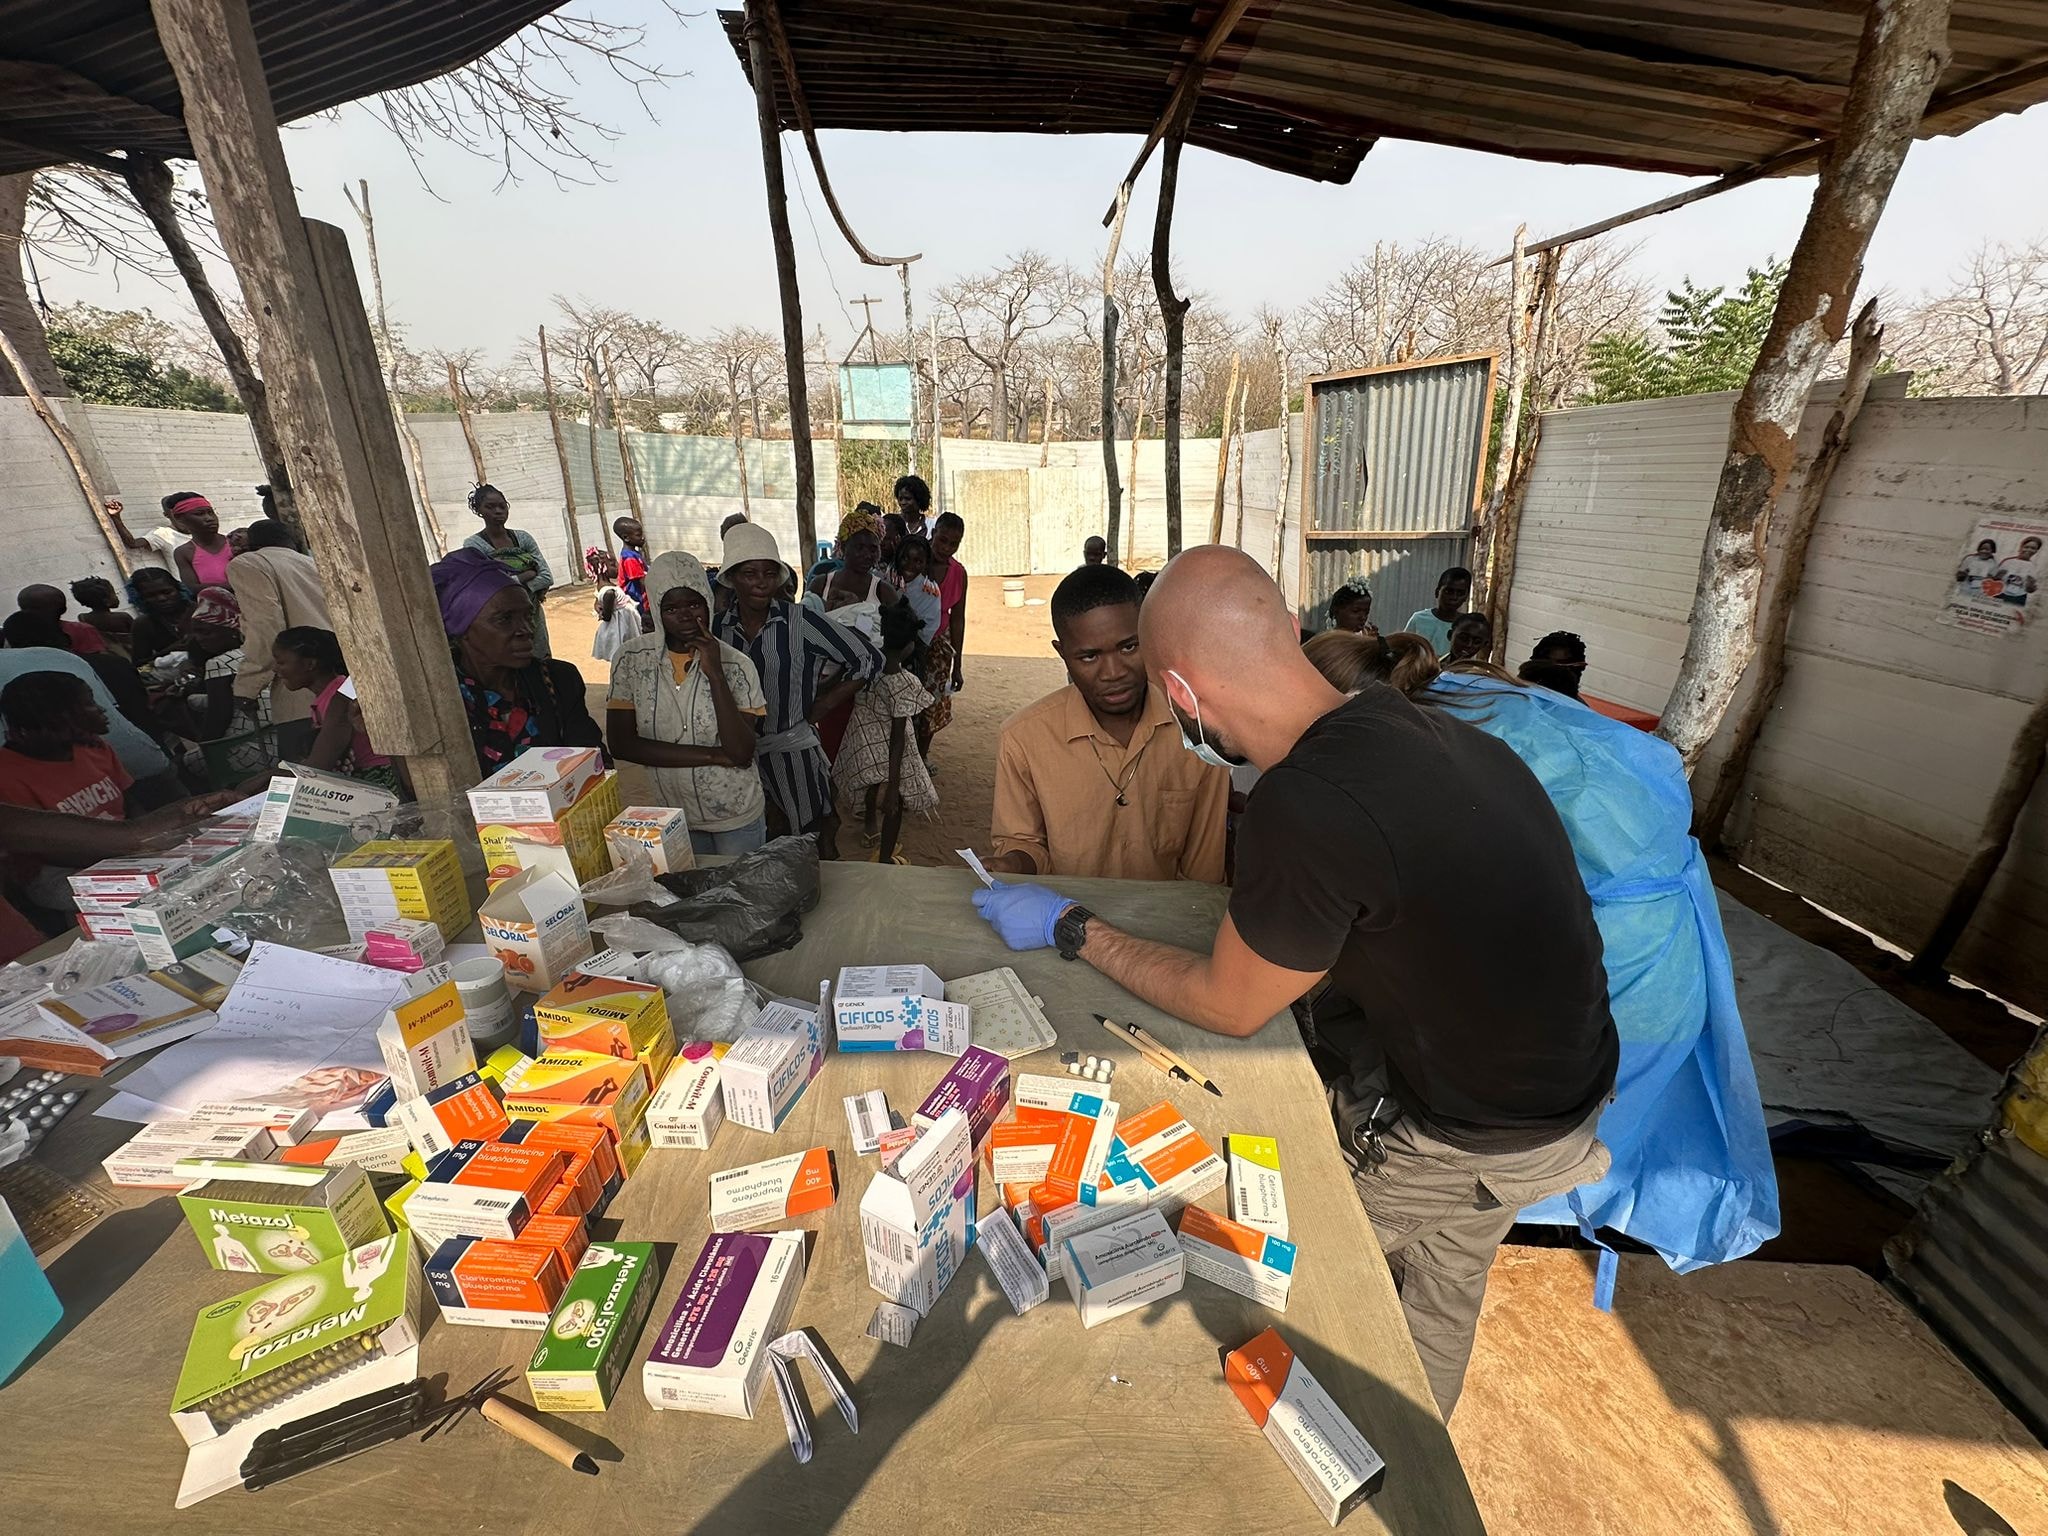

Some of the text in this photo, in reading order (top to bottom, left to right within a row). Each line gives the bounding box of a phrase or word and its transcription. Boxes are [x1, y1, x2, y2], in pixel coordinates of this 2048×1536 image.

[299, 784, 354, 803] MALASTOP
[544, 903, 576, 928] SELORAL
[485, 926, 529, 943] SELORAL
[408, 1000, 454, 1030] Cosmivit-M
[537, 1011, 573, 1023] AMIDOL
[586, 1006, 630, 1020] AMIDOL
[839, 1010, 894, 1025] CIFICOS
[927, 1009, 939, 1042] CIFICOS
[536, 1057, 584, 1066] AMIDOL
[773, 1047, 806, 1097] CIFICOS
[686, 1066, 714, 1111] Cosmivit-M
[506, 1104, 549, 1113] AMIDOL
[653, 1122, 697, 1130] Cosmivit-M
[460, 1141, 477, 1150] 500
[485, 1144, 545, 1157] Claritromicina
[452, 1151, 467, 1160] mg
[477, 1153, 529, 1165] bluepharma
[805, 1168, 819, 1176] mg
[726, 1177, 782, 1196] bluepharma
[805, 1176, 821, 1186] 400
[928, 1158, 964, 1211] CIFICOS
[335, 1176, 366, 1213] Metazol
[732, 1186, 783, 1203] Ibuprofeno
[1259, 1173, 1269, 1217] bluepharma
[1267, 1174, 1278, 1209] Cetirizina
[208, 1208, 296, 1228] Metazol
[1271, 1239, 1292, 1251] 100 mg
[935, 1230, 949, 1294] CIFICOS
[430, 1272, 448, 1280] 500
[459, 1274, 527, 1286] Claritromicina
[770, 1275, 780, 1283] 16
[462, 1282, 521, 1292] bluepharma
[585, 1255, 639, 1348] Metazol 500
[661, 1311, 688, 1357] Amoxicilina
[688, 1279, 703, 1300] Ácido
[698, 1238, 723, 1278] Clavulânico
[239, 1303, 368, 1372] Metazol
[738, 1329, 757, 1365] Generis
[1245, 1363, 1262, 1381] 400
[1256, 1357, 1270, 1374] mg
[1298, 1415, 1350, 1485] bluepharma
[1293, 1428, 1342, 1492] Ibuprofeno
